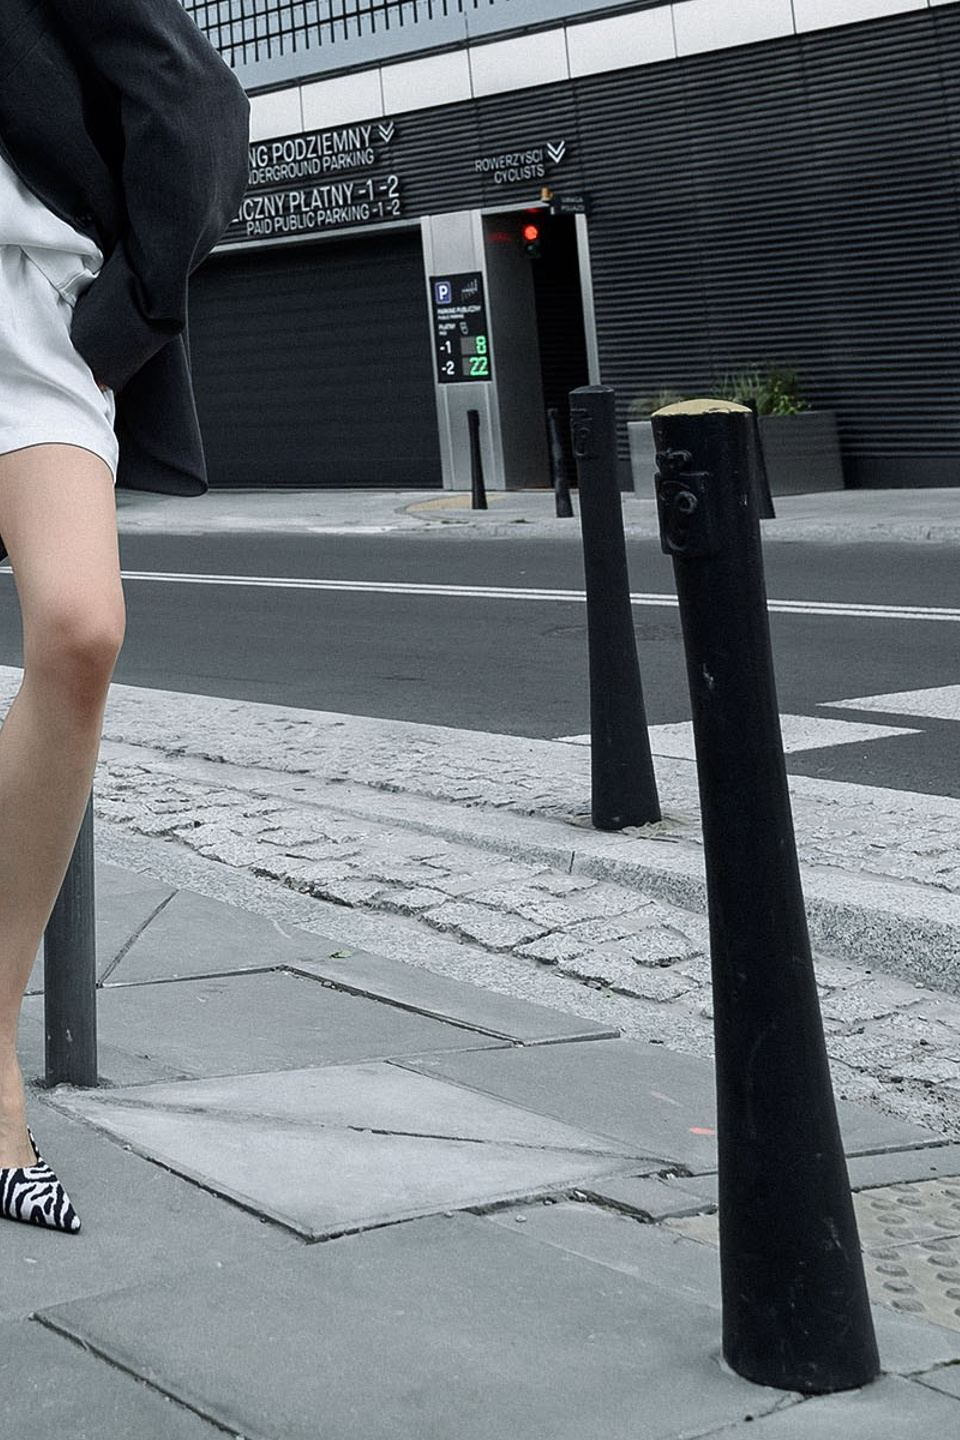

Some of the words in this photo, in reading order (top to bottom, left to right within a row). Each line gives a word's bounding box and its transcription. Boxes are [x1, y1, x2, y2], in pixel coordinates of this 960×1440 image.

[272, 125, 372, 164] PODZIEMNY
[323, 148, 375, 172] PARKING
[494, 163, 545, 184] CYCLISTS
[231, 193, 285, 222] ICZNY
[290, 182, 354, 213] PŁATNY
[358, 179, 374, 201] -1
[379, 175, 400, 198] -2
[247, 218, 273, 236] PAID
[274, 212, 315, 232] PUBLIC
[317, 204, 370, 225] PARKING
[372, 201, 384, 217] -1
[386, 199, 401, 215] -2
[439, 285, 448, 300] P
[439, 340, 452, 354] -1
[475, 335, 487, 354] 8
[441, 361, 455, 375] -2
[468, 356, 489, 376] 22
